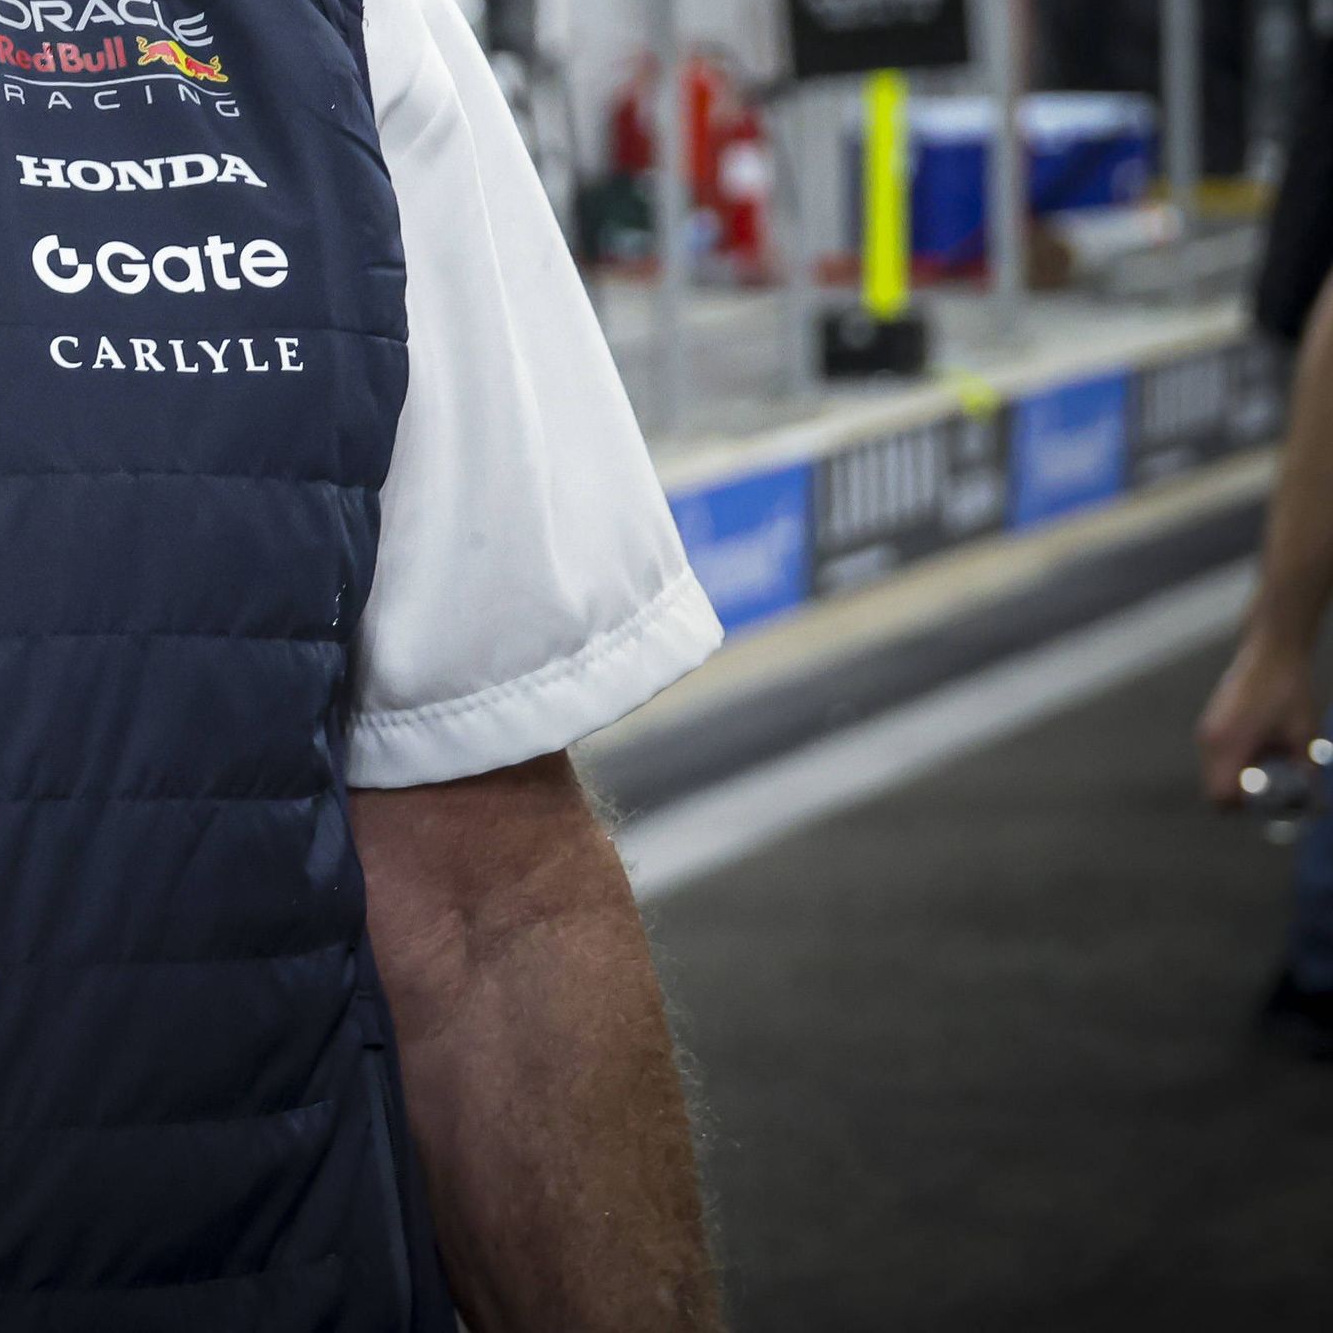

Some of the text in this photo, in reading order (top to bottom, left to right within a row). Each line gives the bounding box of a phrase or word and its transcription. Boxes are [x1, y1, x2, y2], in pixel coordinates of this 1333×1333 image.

[3, 83, 240, 118] RACING
[15, 153, 268, 192] HONDA
[49, 335, 304, 374] CARLYLE
